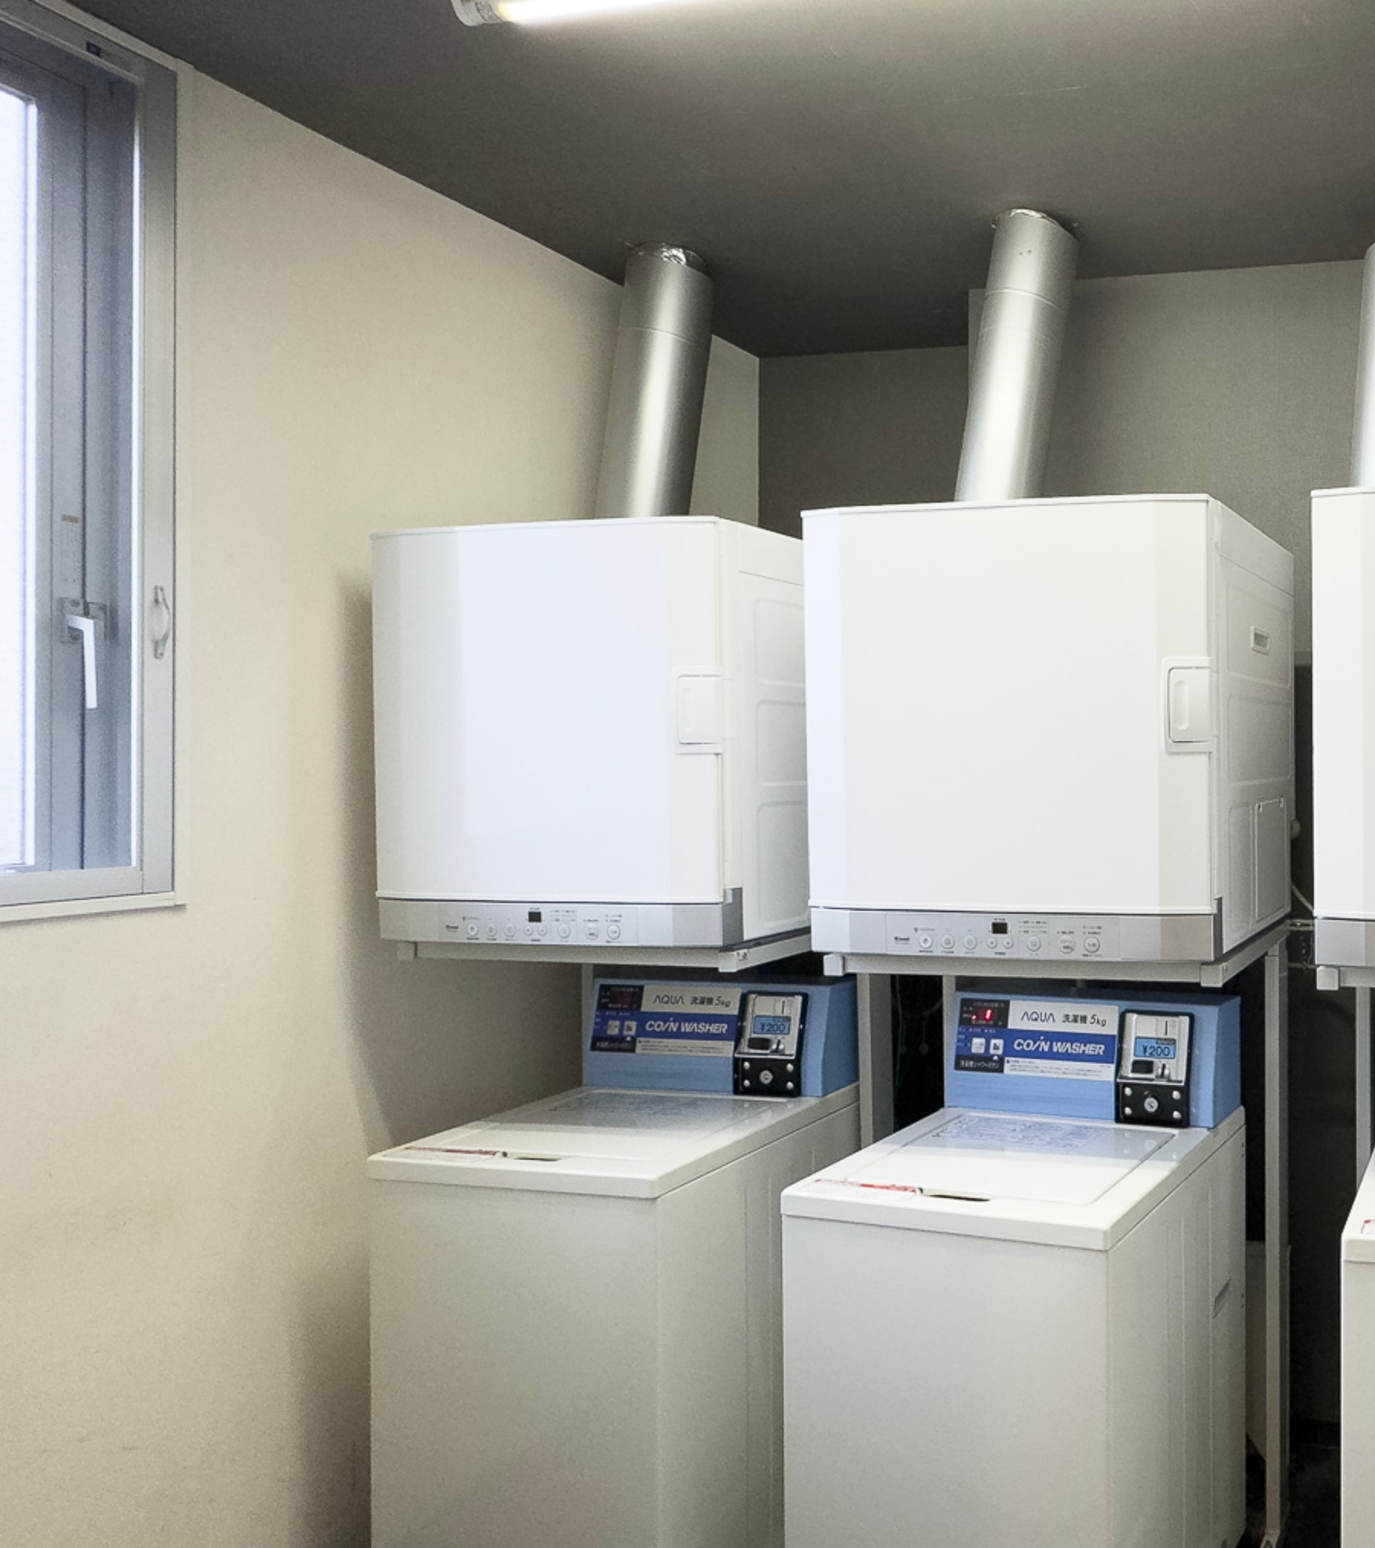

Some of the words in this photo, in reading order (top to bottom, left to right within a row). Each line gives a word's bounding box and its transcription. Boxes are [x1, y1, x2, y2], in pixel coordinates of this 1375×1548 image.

[653, 994, 685, 1006] AQUA
[1020, 1010, 1056, 1023] AQUA
[1089, 1014, 1107, 1028] 5kg
[681, 1022, 728, 1034] WASHER
[1052, 1041, 1105, 1056] WASHER
